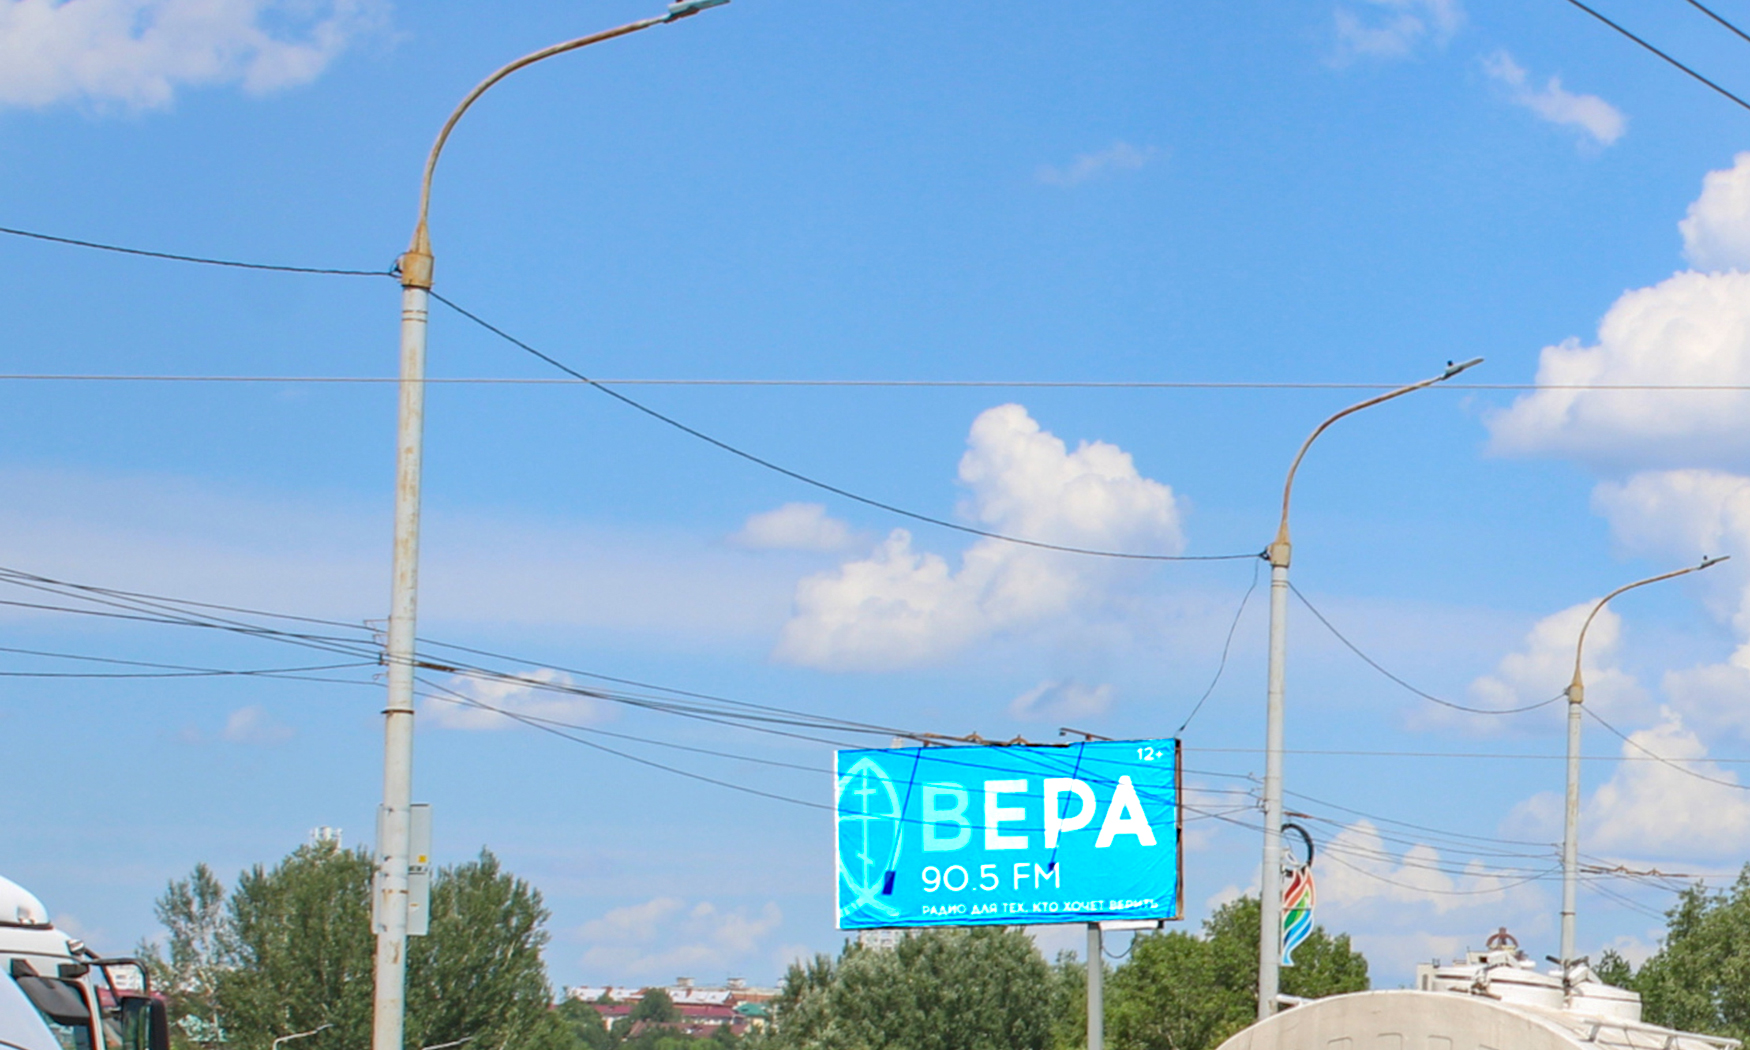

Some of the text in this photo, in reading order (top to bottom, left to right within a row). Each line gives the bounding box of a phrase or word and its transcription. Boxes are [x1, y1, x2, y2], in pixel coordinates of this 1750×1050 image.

[1137, 747, 1163, 761] 12+
[921, 775, 1157, 853] ВЕРА
[922, 862, 1060, 892] 90.5 FM
[922, 904, 966, 916] РАДИО
[971, 903, 997, 914] ДЛЯ
[1033, 901, 1059, 912] КТО
[1063, 900, 1104, 912] ХОЧЕТ
